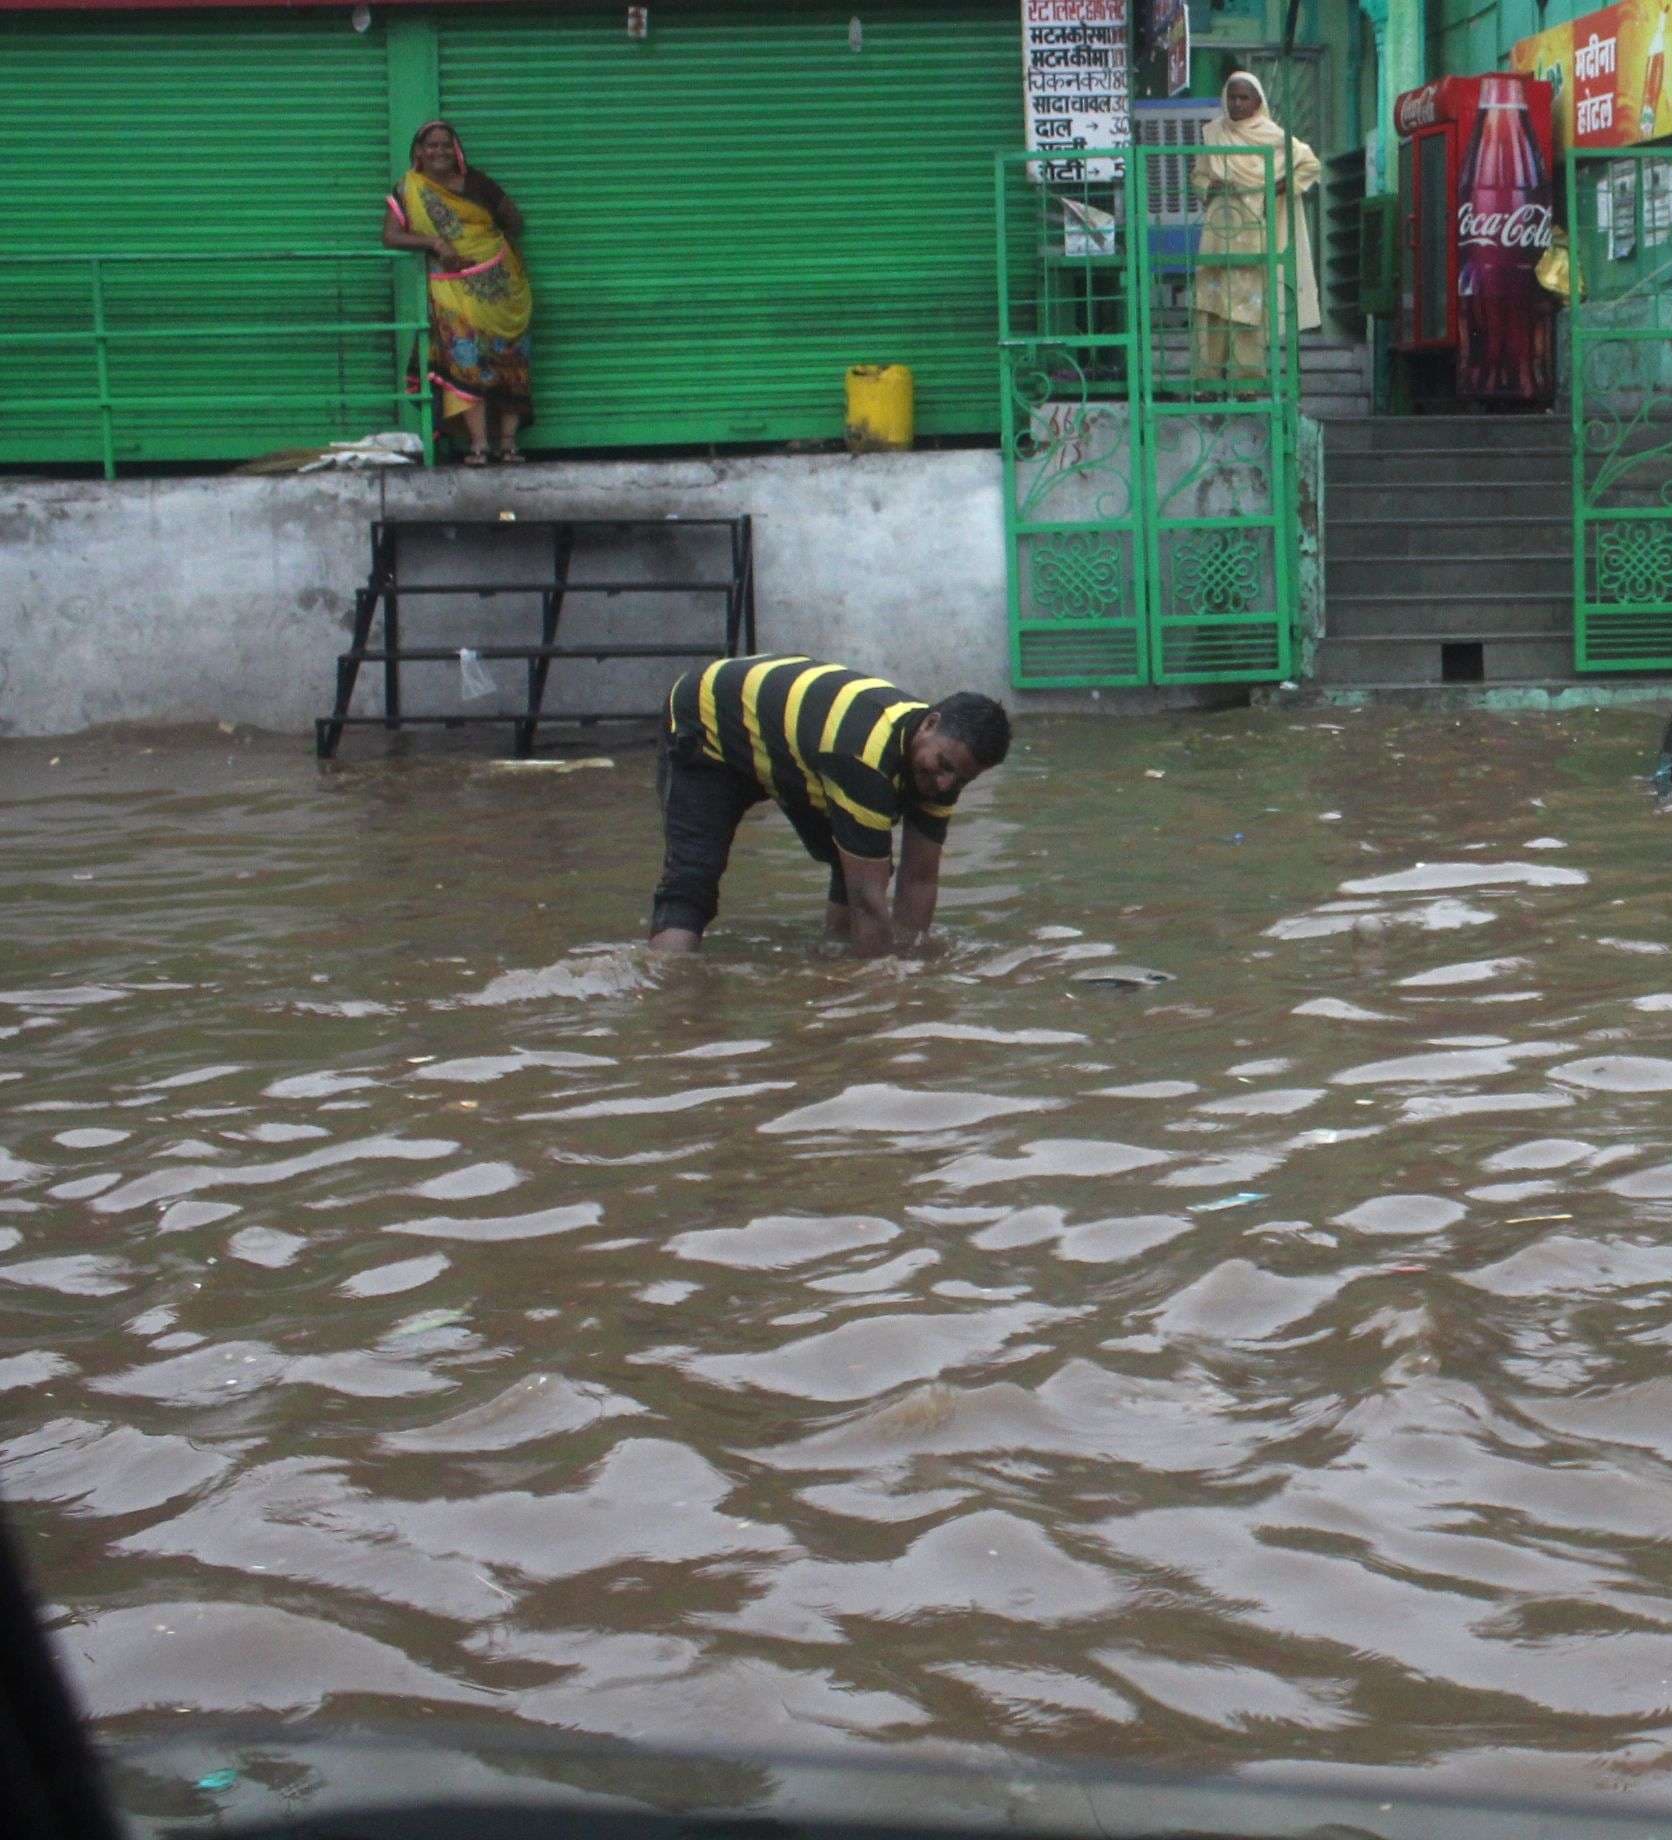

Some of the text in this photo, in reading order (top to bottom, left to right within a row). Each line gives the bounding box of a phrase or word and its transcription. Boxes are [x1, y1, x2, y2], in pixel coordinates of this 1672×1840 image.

[1575, 33, 1616, 82] मदीना
[1034, 118, 1073, 137] दाल
[1577, 88, 1615, 135] होटल
